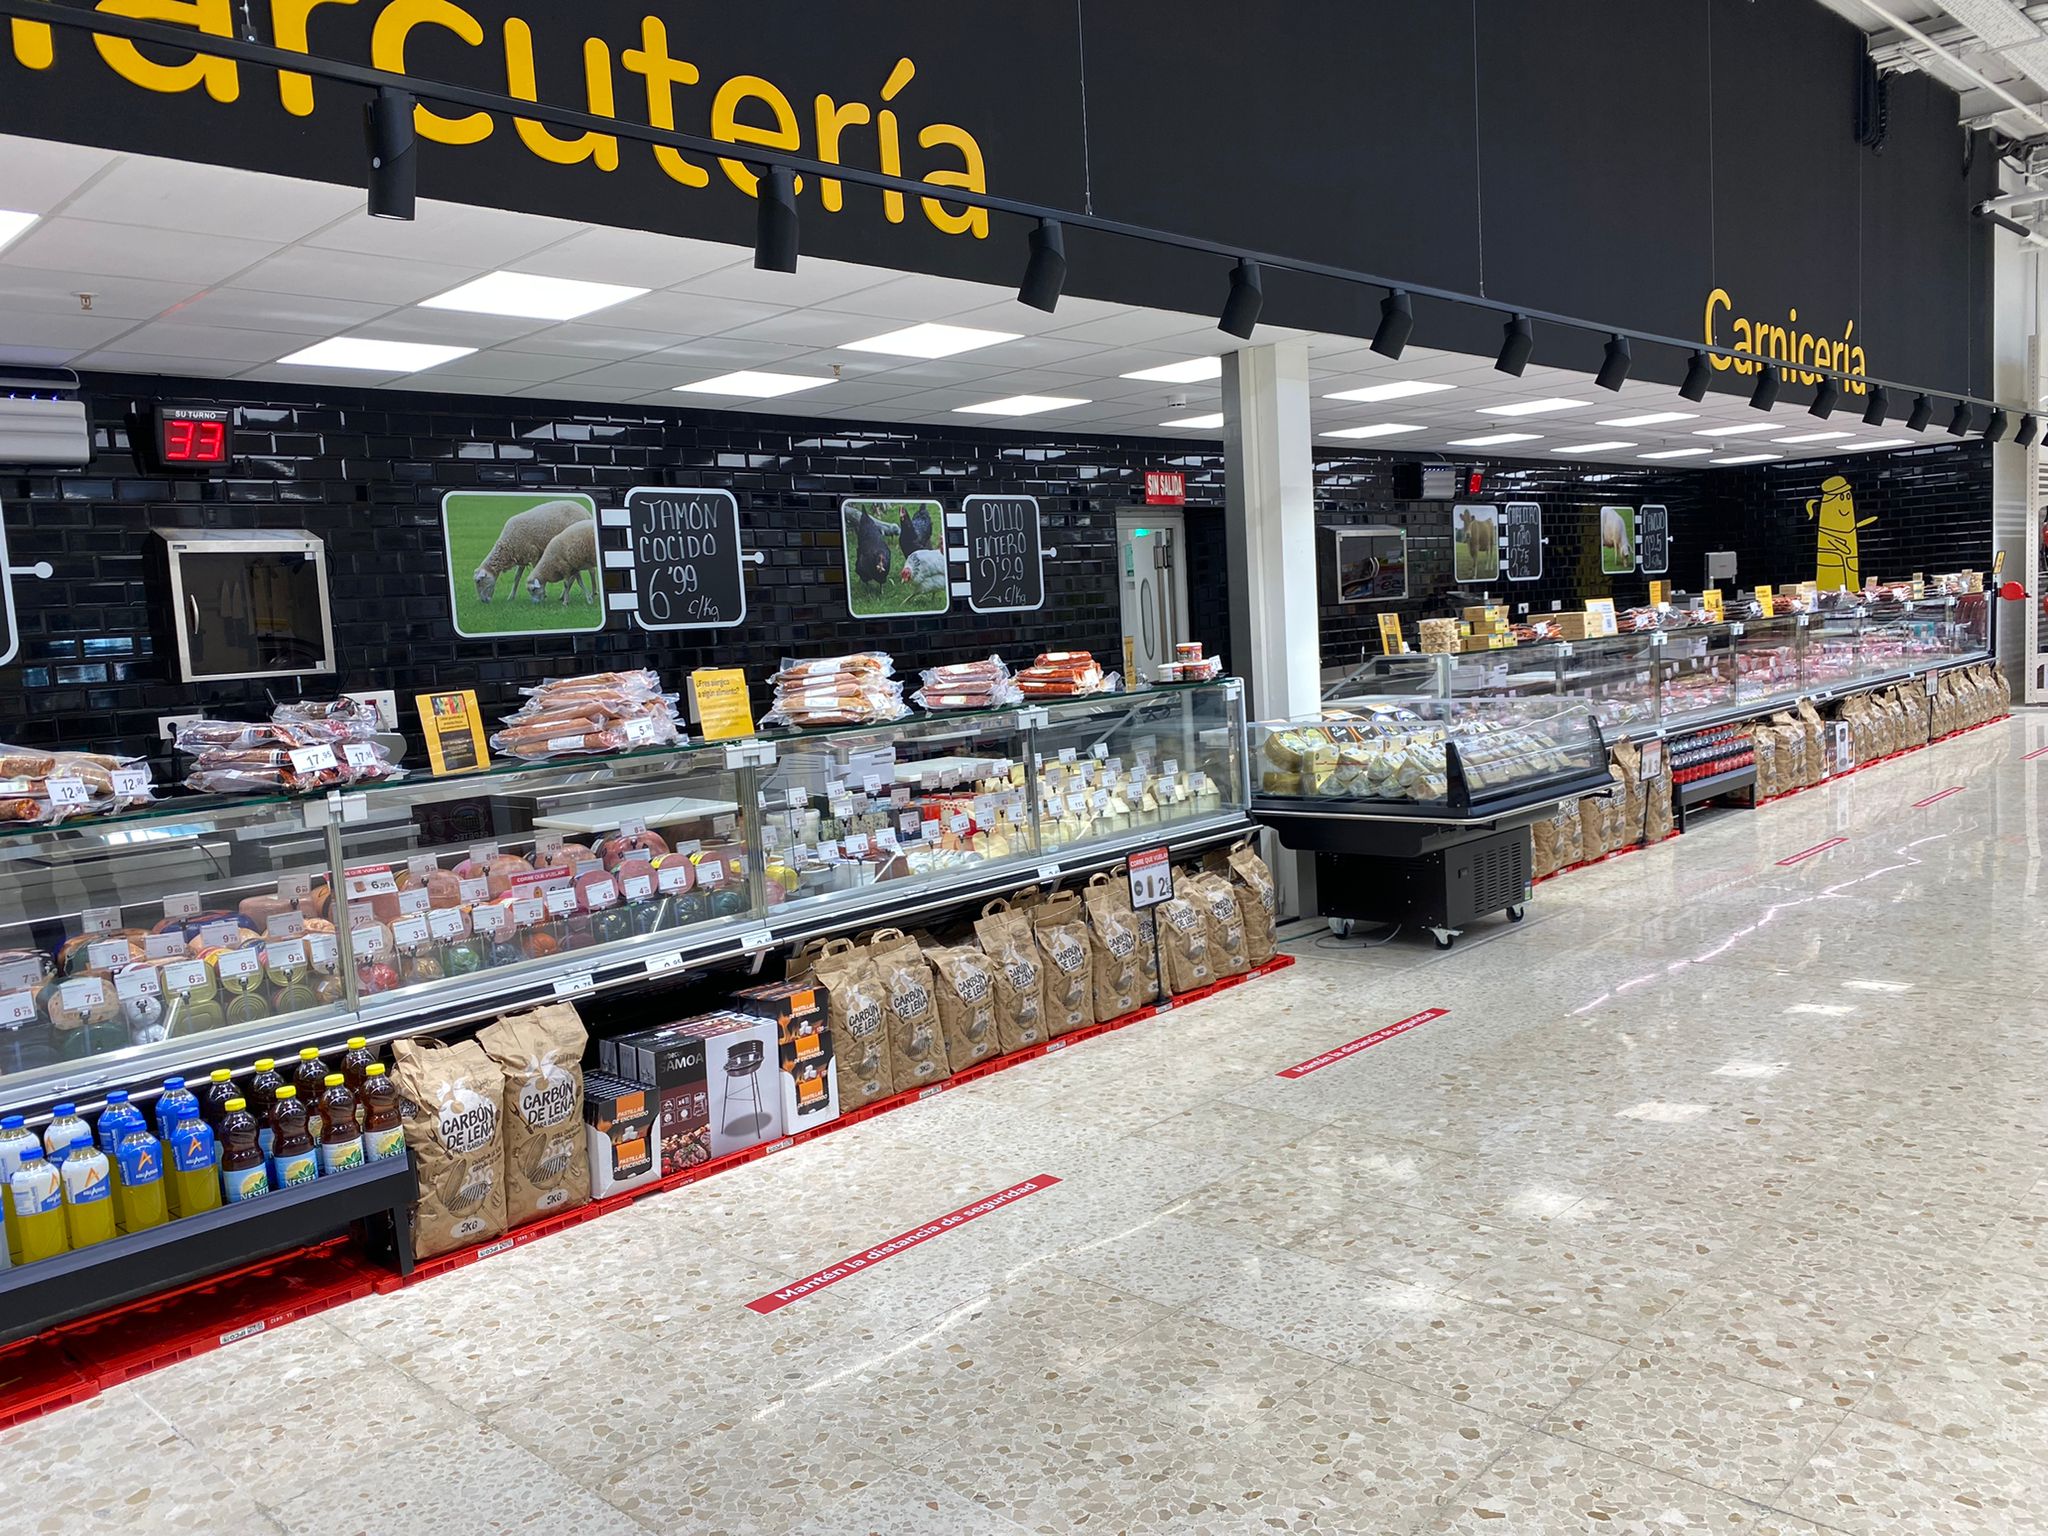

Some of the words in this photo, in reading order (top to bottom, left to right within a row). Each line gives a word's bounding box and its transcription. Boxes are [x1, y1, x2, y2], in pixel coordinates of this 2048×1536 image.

[12, 0, 990, 240] arcutería
[1705, 288, 1866, 395] Carnicería
[175, 410, 187, 418] SU
[188, 411, 216, 419] TURNO
[167, 421, 223, 459] 33
[1147, 475, 1159, 496] SIN
[1159, 475, 1184, 497] SALIDA
[640, 495, 720, 534] JAMÓN
[982, 503, 1024, 534] POLLO
[639, 531, 717, 563] COCIDO
[792, 1002, 815, 1013] PASTILLAS
[893, 986, 925, 1009] CARBÓN
[898, 1005, 909, 1017] DE
[848, 1003, 878, 1027] CARBÓN
[660, 1052, 704, 1073] SAMOA
[798, 1046, 820, 1057] PASTILLAS
[523, 1080, 574, 1111] CARBÓN
[801, 1090, 823, 1100] PASTILLAS
[441, 1103, 494, 1136] CARBÓN
[528, 1108, 546, 1125] DE
[548, 1094, 575, 1119] LEÑA
[617, 1106, 645, 1118] PASTILLAS
[446, 1131, 466, 1151] DE
[468, 1118, 495, 1144] LEÑA
[619, 1153, 646, 1164] PASTILLAS
[774, 1266, 848, 1301] Mantén
[844, 1257, 866, 1272] la
[865, 1223, 941, 1261] distancia
[940, 1212, 964, 1228] de
[962, 1181, 1038, 1218] seguridad
